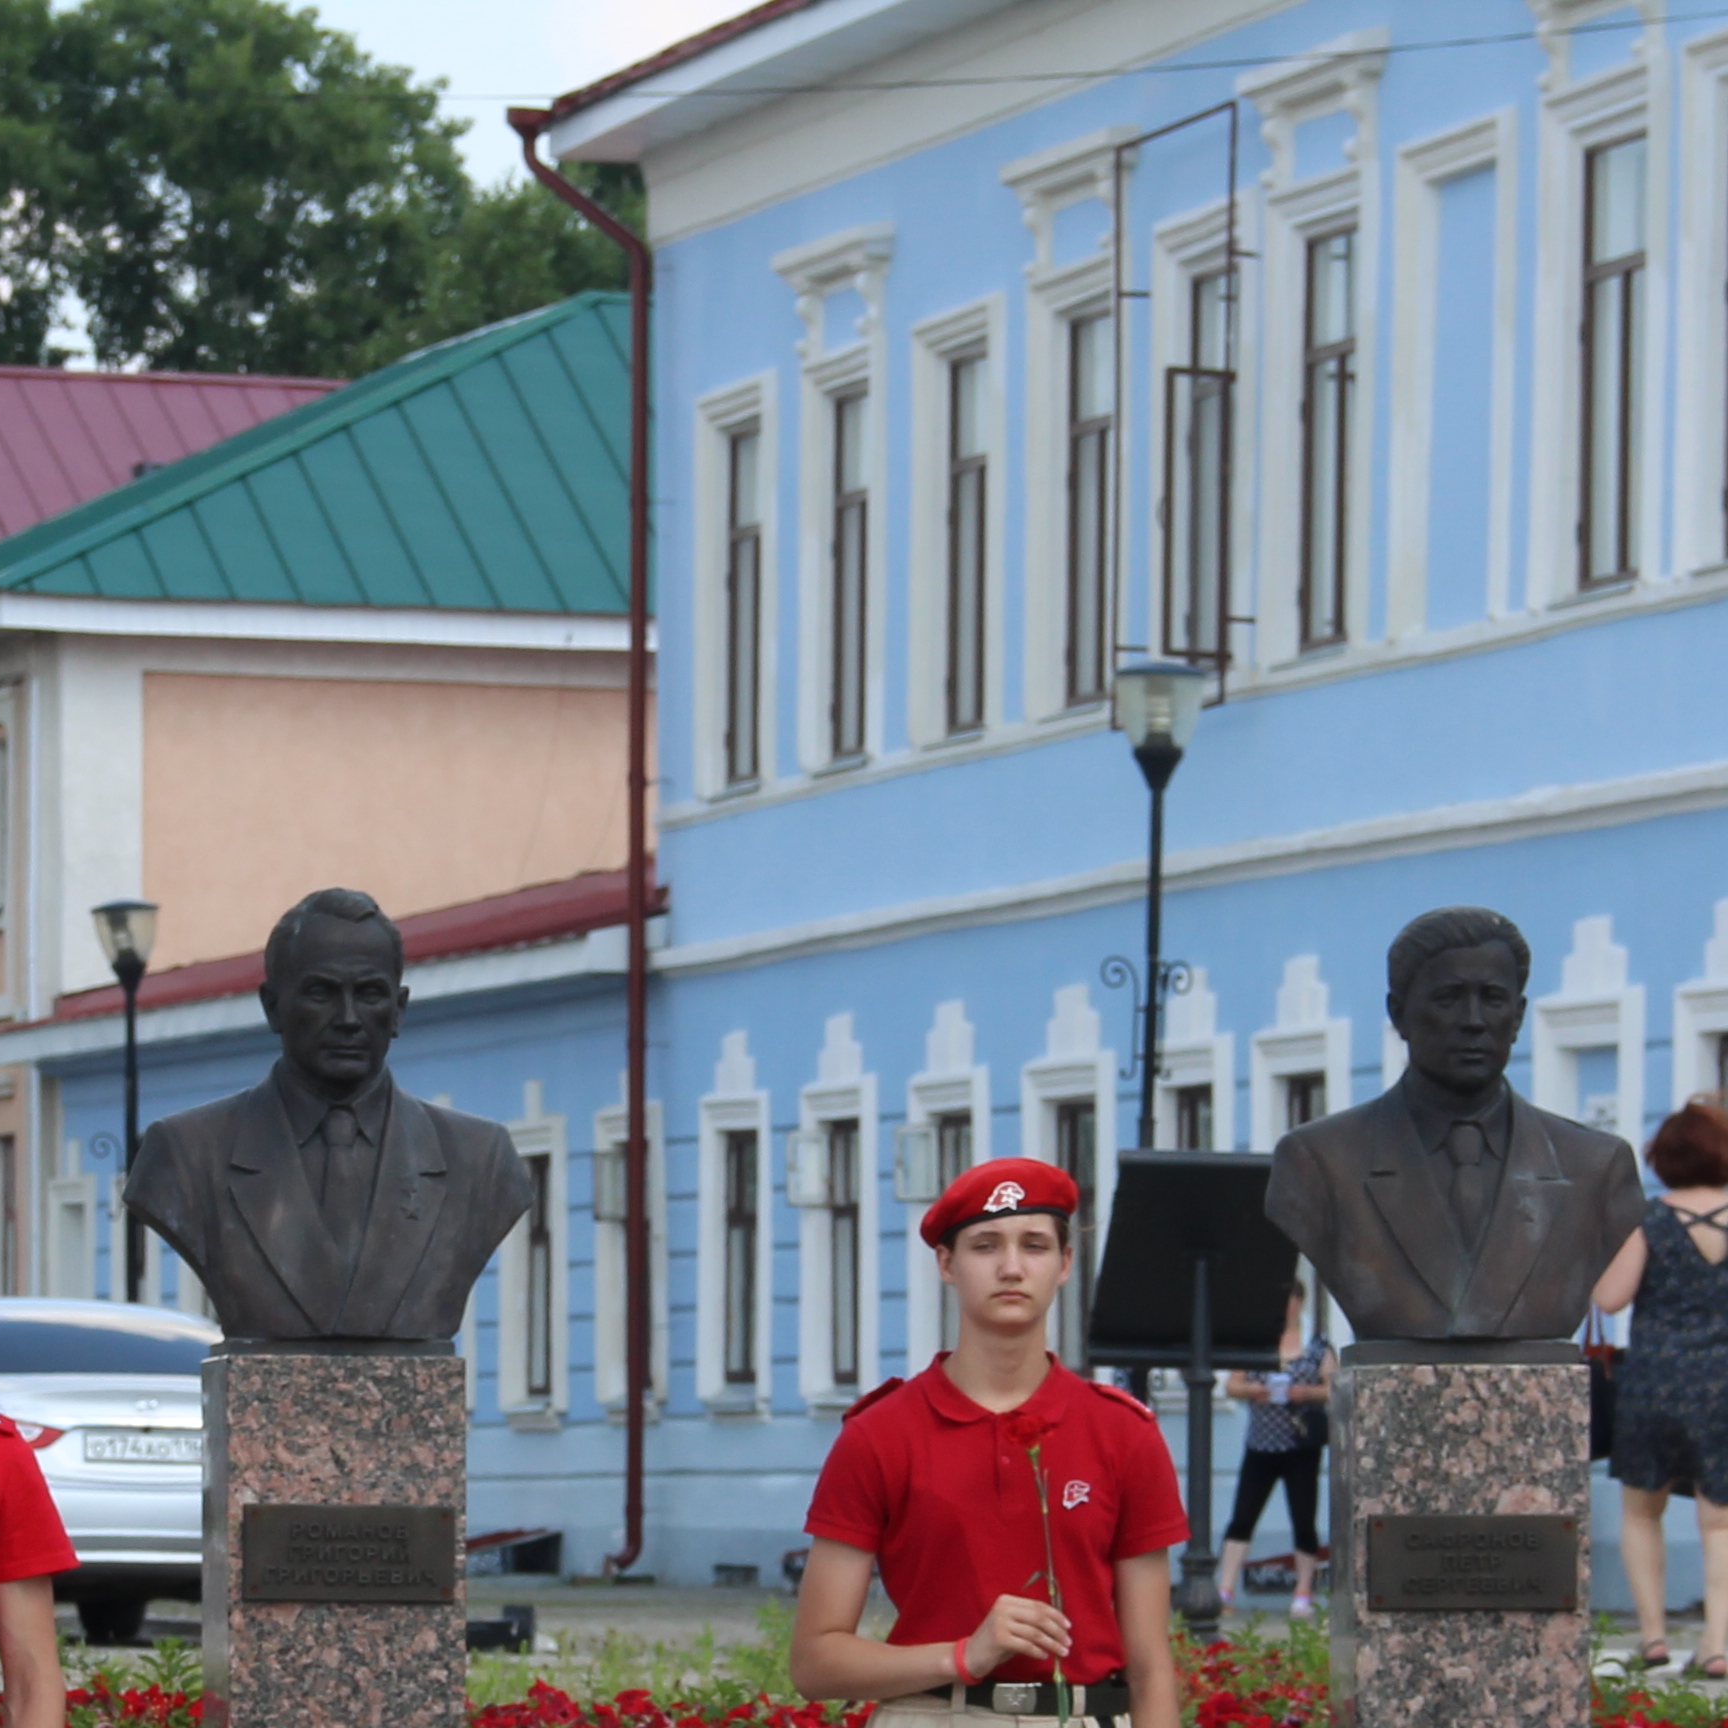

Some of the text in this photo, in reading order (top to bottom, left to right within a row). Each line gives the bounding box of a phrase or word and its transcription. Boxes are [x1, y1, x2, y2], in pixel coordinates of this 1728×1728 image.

[289, 1522, 410, 1541] РОМАНОВ
[1404, 1531, 1540, 1550] САФРОНОВ
[286, 1542, 411, 1563] ГРИГОРИЙ
[1440, 1553, 1503, 1573] ПЕТР
[262, 1566, 437, 1587] ГРИГОРЬЕВИЧ
[1401, 1576, 1543, 1595] СЕРГЕЕВИЧ
